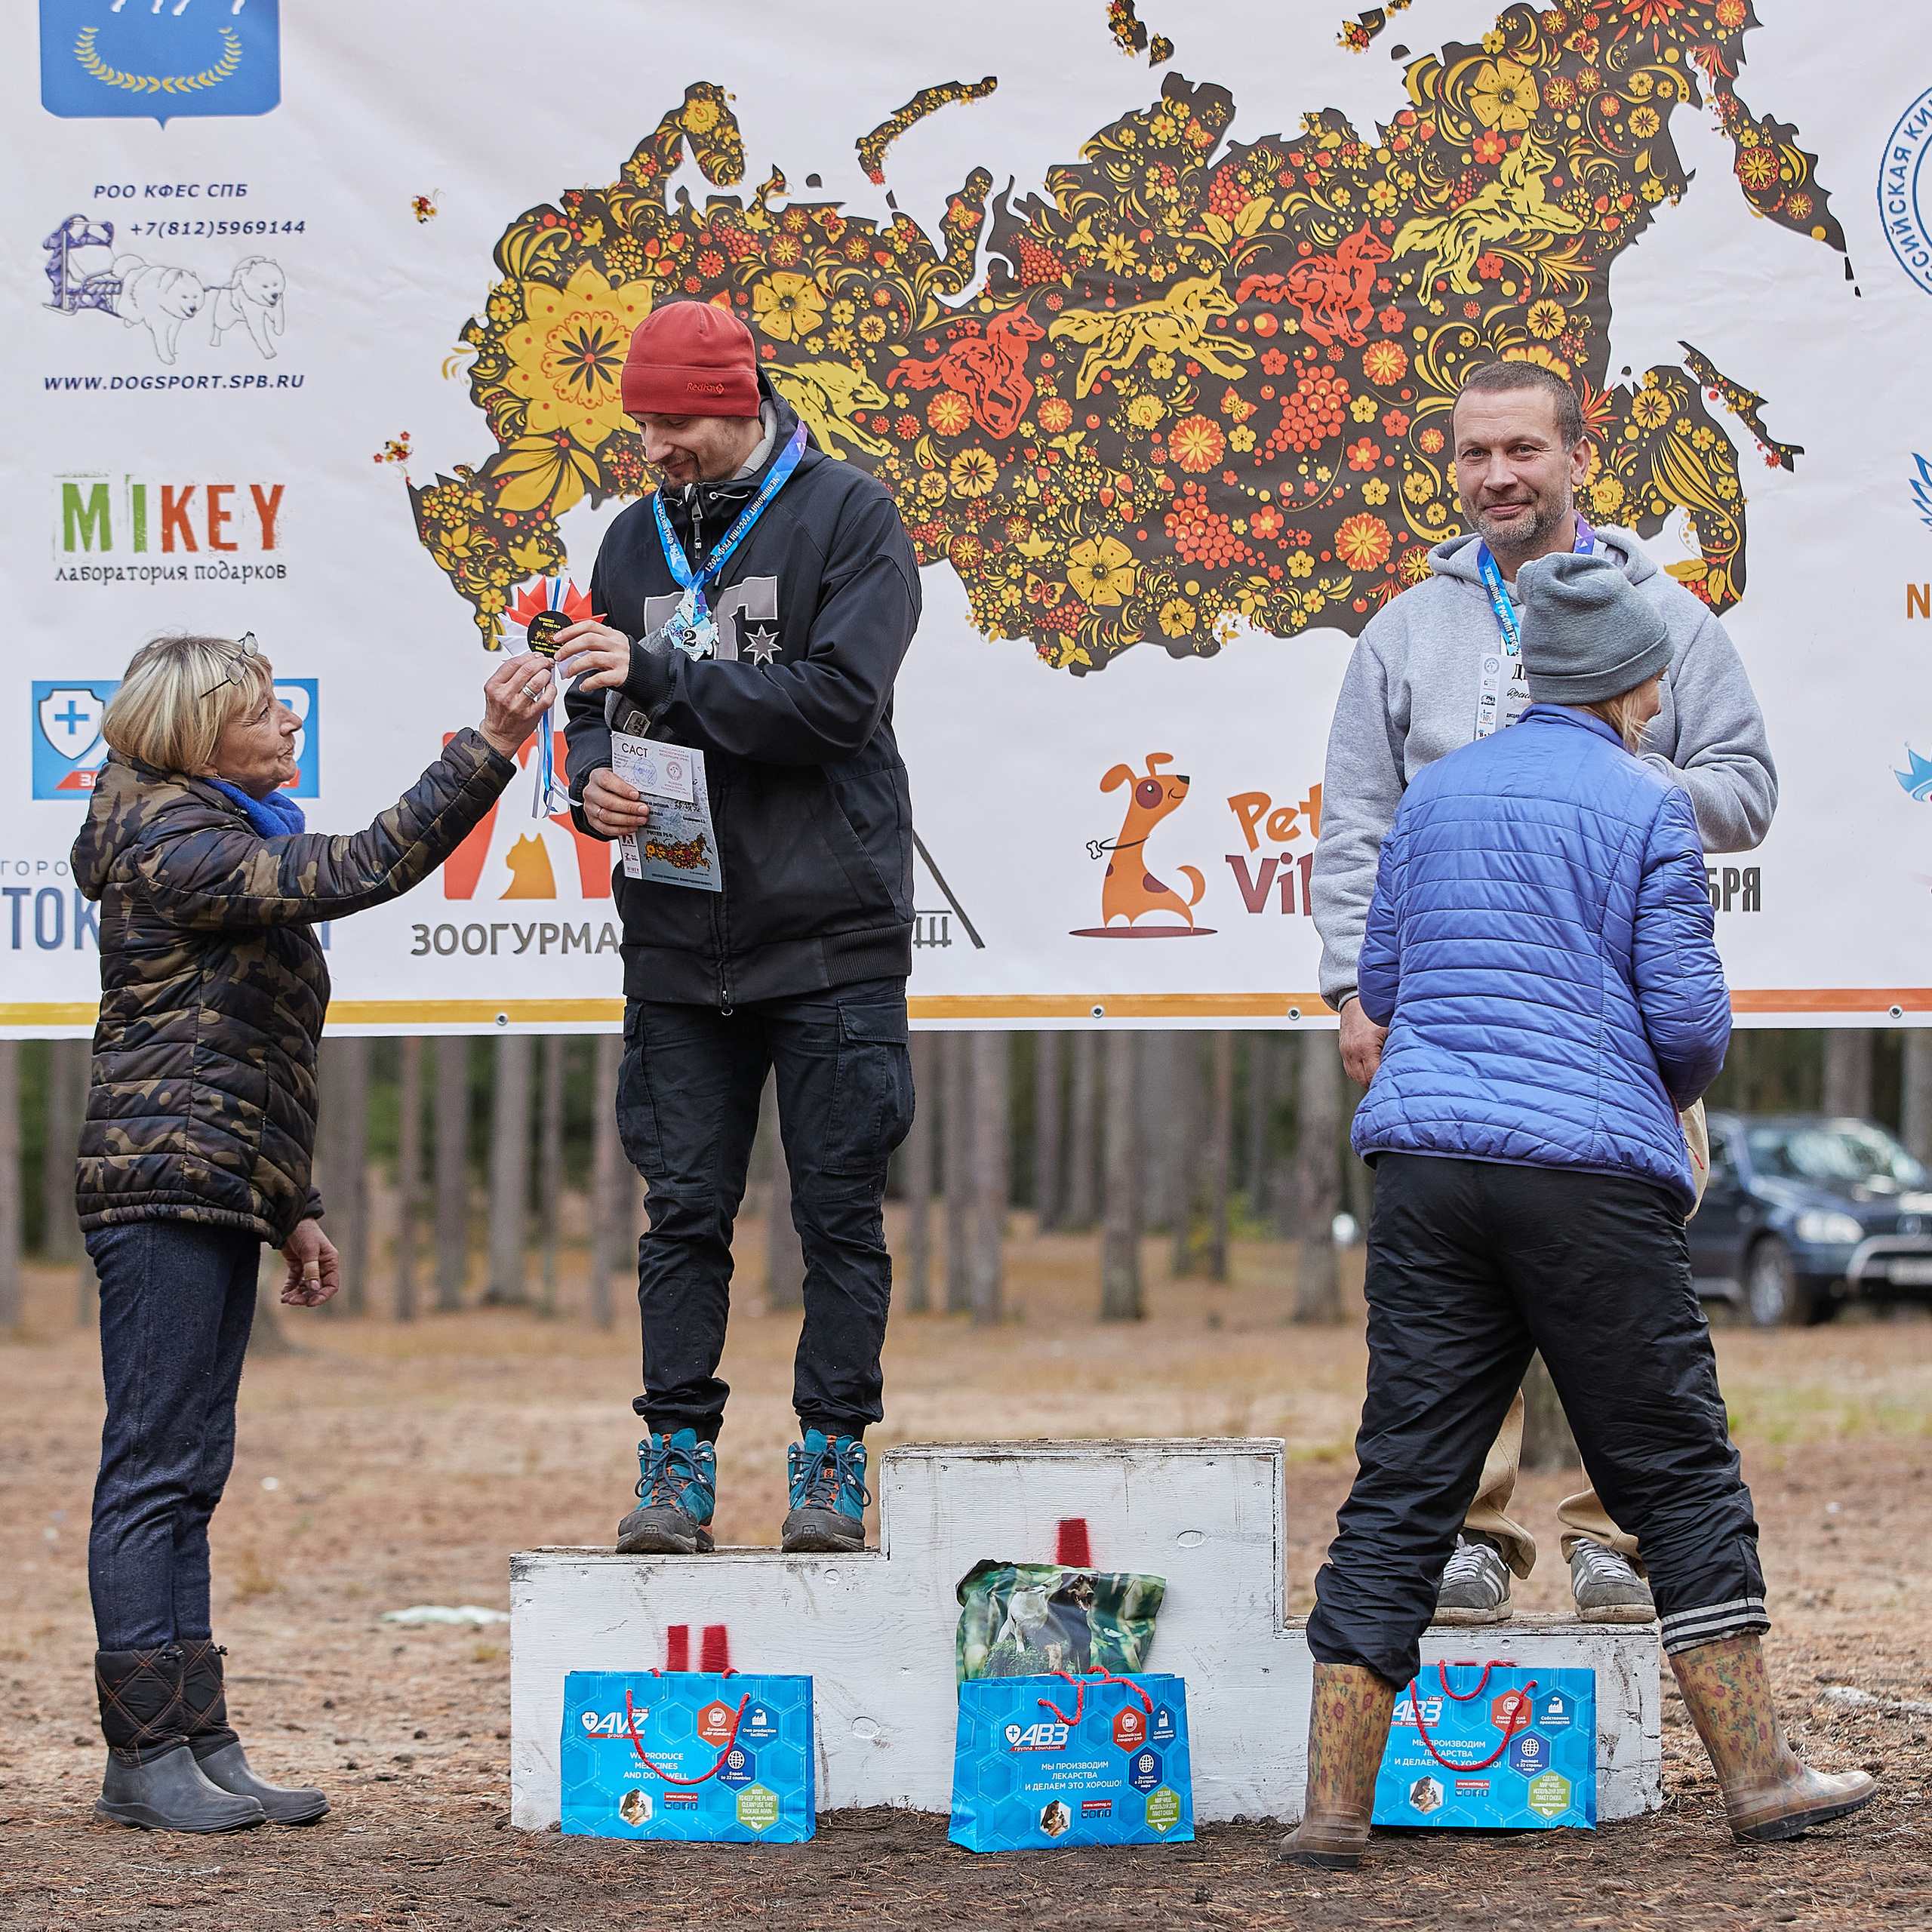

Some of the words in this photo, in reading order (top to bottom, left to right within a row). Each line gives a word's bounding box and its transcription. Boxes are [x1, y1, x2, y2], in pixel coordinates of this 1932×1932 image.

[1904, 100, 1932, 140] КИ
[94, 184, 136, 198] РОО
[145, 183, 201, 198] КФЕС
[208, 183, 248, 198] СПБ
[130, 220, 306, 238] +7(812)5969144
[44, 374, 305, 391] WWW.DOGSPORT.SPB.RU
[749, 477, 780, 516] ЧЕМПИОНАТ
[62, 483, 286, 553] MIKEY
[730, 514, 752, 540] РОССИИ
[663, 528, 674, 544] РКФ
[669, 543, 681, 560] 2021
[718, 538, 733, 556] РКФ
[55, 565, 188, 585] лаборатория
[195, 561, 287, 584] подарков
[705, 554, 721, 572] 2021
[1497, 604, 1514, 632] РОССИИ
[1507, 631, 1519, 648] РКФ
[684, 630, 697, 647] 2
[622, 743, 648, 758] CACT
[1227, 783, 1322, 853] Pet
[411, 923, 619, 955] ЗООГУРМА
[1392, 1700, 1443, 1721] АВЗ
[591, 1712, 649, 1734] AVZ
[1014, 1724, 1069, 1746] АВЗ
[1430, 1740, 1486, 1749] ПРОИЗВОДИМ
[1056, 1761, 1109, 1770] ПРОИЗВОДИМ
[1032, 1783, 1066, 1791] ДЕЛАЕМ
[1086, 1780, 1122, 1789] ХОРОШО!
